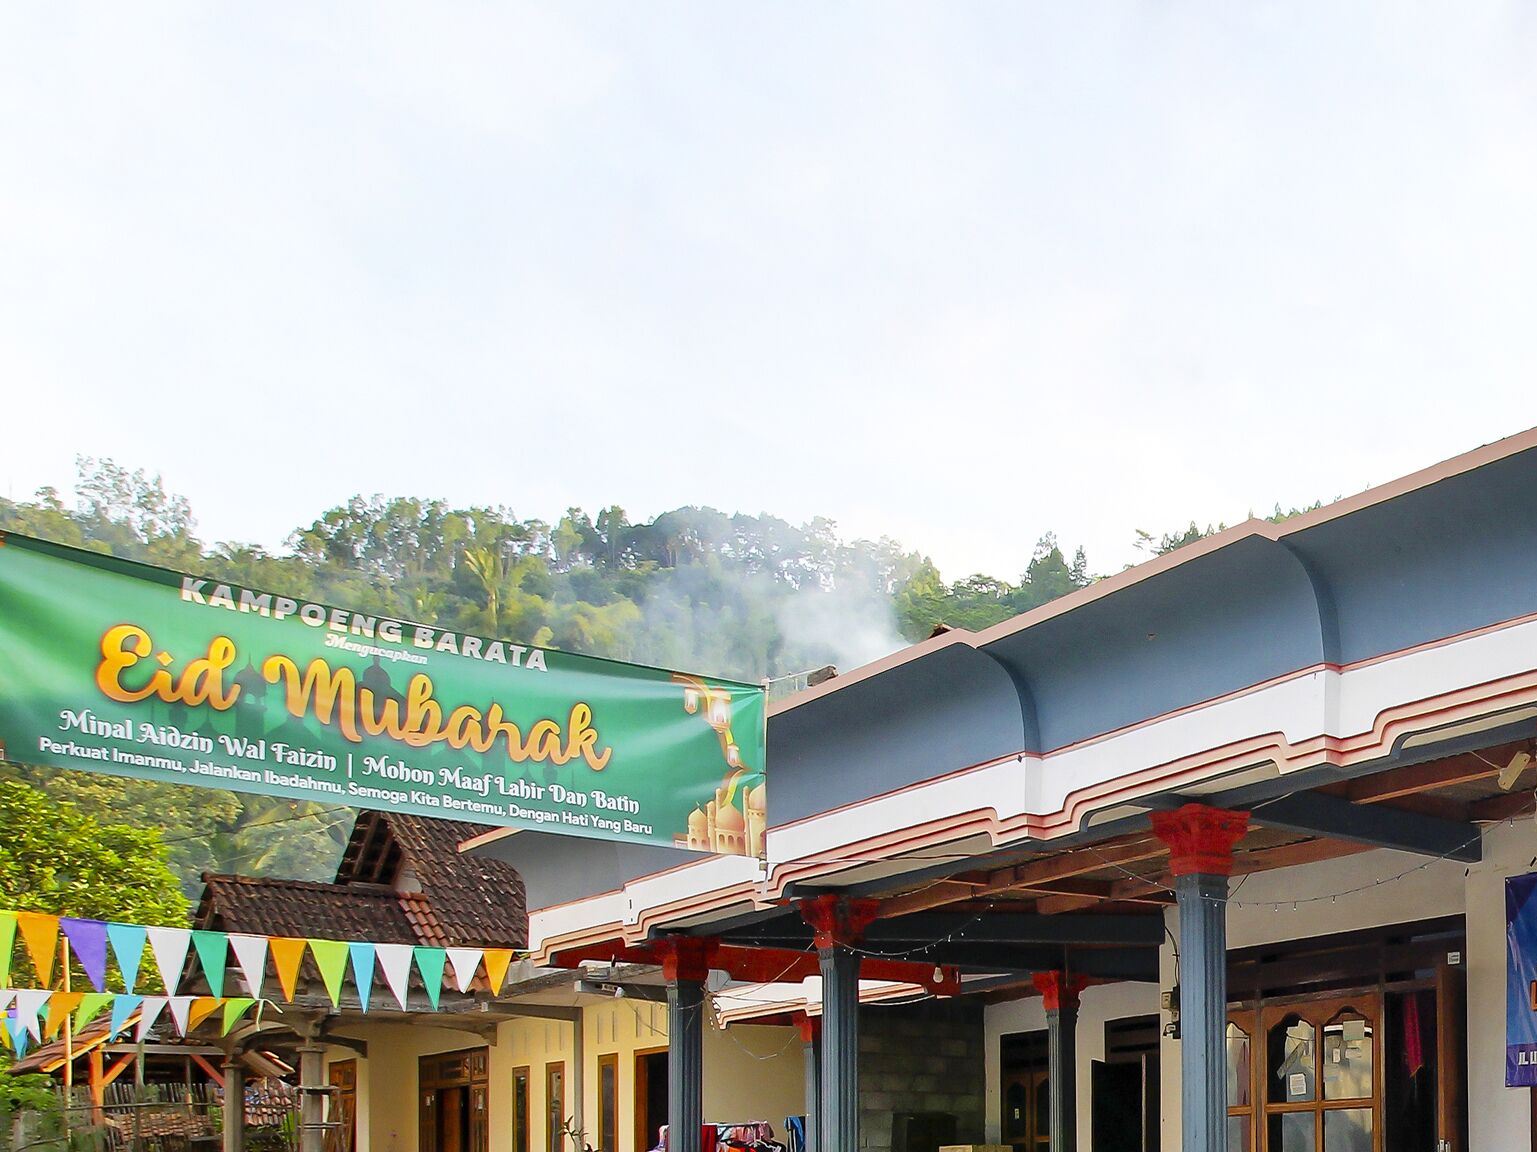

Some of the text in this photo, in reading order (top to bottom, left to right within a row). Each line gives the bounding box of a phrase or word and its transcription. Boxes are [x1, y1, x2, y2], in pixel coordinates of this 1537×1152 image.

[180, 576, 548, 672] KAMPOENG BARATA
[96, 624, 612, 771] Eid Mubarak
[39, 737, 653, 835] Perkuat Imanmu, Jalankan Ibadahmu, Semoga Kita Bertemu, Dengan Hati Yang Baru
[58, 709, 133, 741] Minal
[137, 723, 213, 753] Aidzin
[218, 735, 265, 760] Wal
[271, 743, 337, 771] Faizin
[362, 755, 434, 785] Mohon
[438, 767, 492, 797] Maaf
[494, 775, 545, 800] Lahir
[549, 783, 587, 808] Dan
[591, 790, 640, 815] Batin
